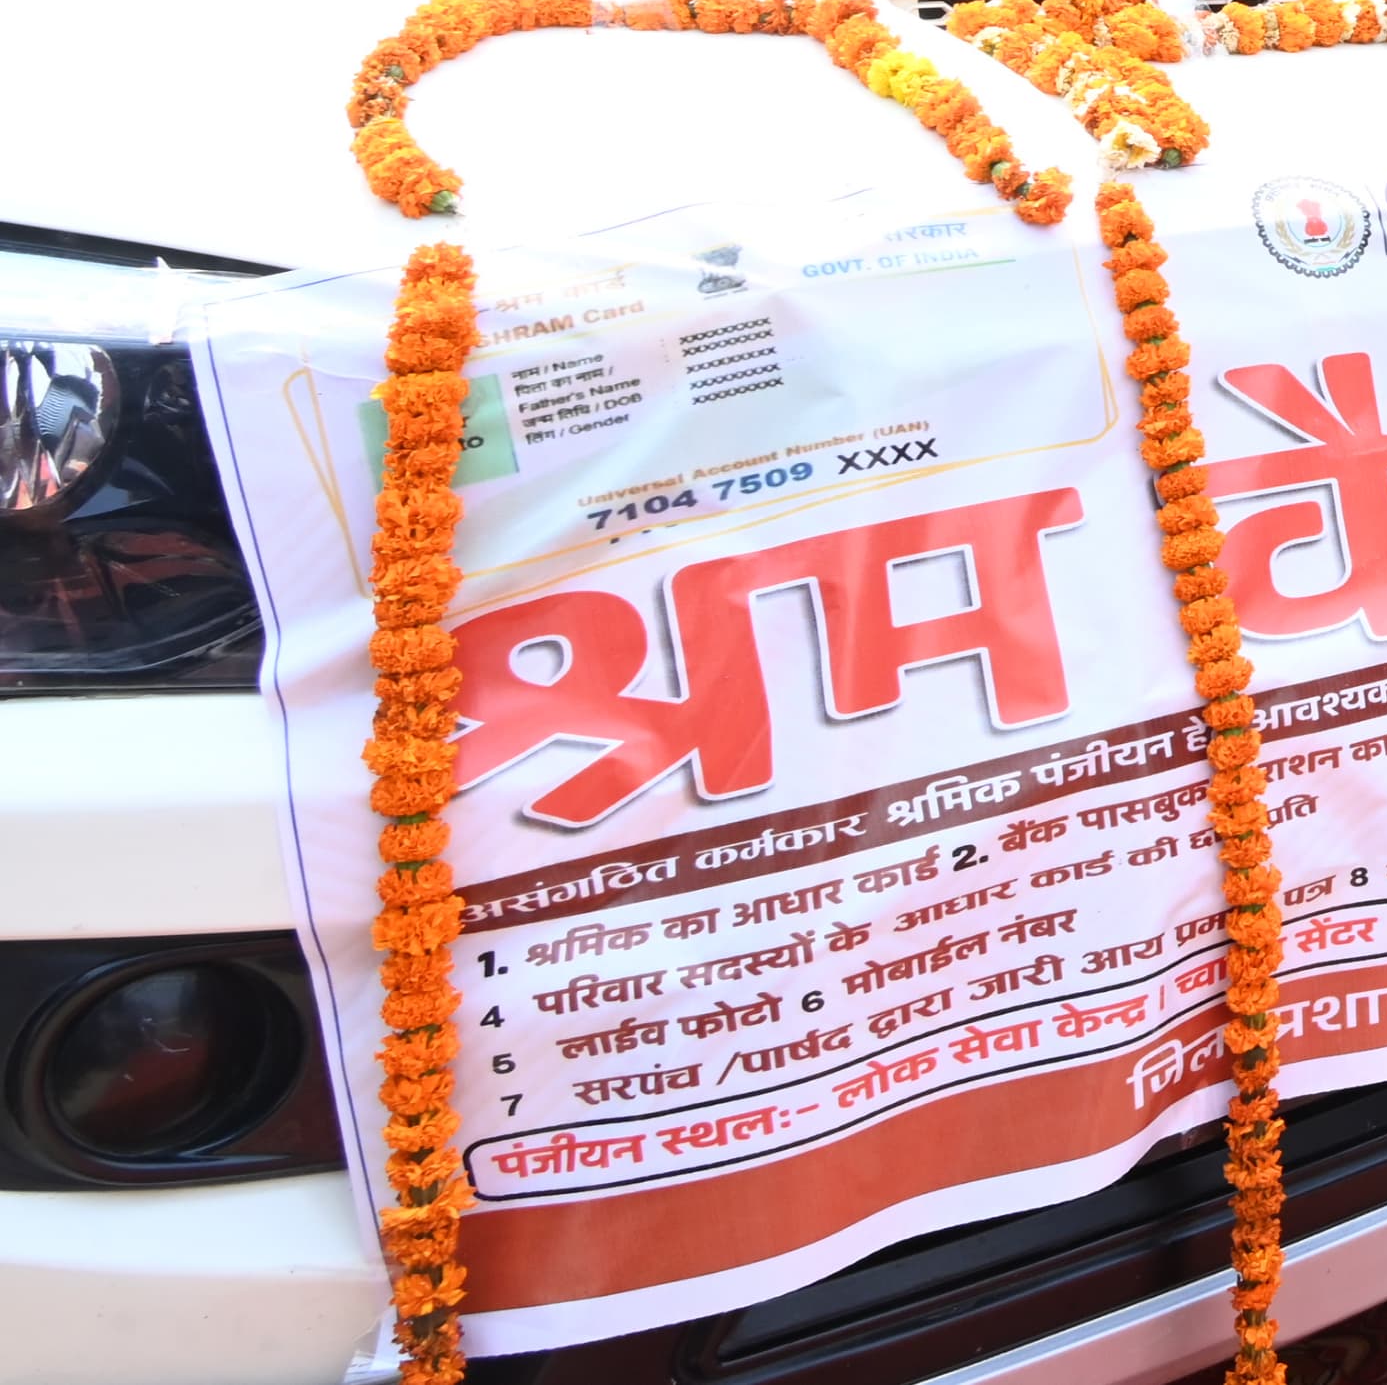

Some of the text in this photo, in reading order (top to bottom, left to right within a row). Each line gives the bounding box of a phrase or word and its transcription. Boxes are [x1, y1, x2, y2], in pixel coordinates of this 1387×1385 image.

[801, 246, 981, 278] GOVT. OF INDIA
[583, 299, 646, 325] Card
[518, 376, 642, 414] Father's Name
[552, 352, 605, 373] Name
[604, 391, 644, 411] DOB
[568, 412, 631, 437] Gender
[576, 419, 932, 508] Universal Account Number (UAN)
[586, 437, 941, 532] 7104 7509 XXXX
[448, 485, 1086, 829] श्रम
[462, 855, 680, 924] असंगठित
[695, 811, 869, 871] कर्मकार
[886, 768, 1023, 830] श्रमिक
[1029, 730, 1176, 788] पंजीयन
[477, 949, 508, 978] 1.
[525, 920, 653, 968] श्रमिक
[660, 905, 720, 942] का
[731, 878, 845, 929] आधार
[853, 844, 941, 896] कार्ड
[951, 844, 989, 873] 2.
[997, 814, 1069, 855] बैंक
[1076, 779, 1209, 831] पासबुक
[479, 1005, 506, 1030] 4
[532, 969, 669, 1017] परिवार
[676, 929, 817, 990] सदस्यों
[823, 920, 873, 956] के
[893, 877, 1021, 934] आधार
[1029, 848, 1116, 889] कार्ड
[1126, 834, 1180, 869] की
[491, 906, 1079, 1075] 5 लाईव फोटो 6 मोबाईल नंबर
[500, 1093, 525, 1117] 7
[573, 1062, 703, 1107] सरपंच
[867, 987, 956, 1040] द्वारा
[967, 955, 1066, 1002] जारी
[1079, 932, 1167, 975] आय
[1282, 872, 1337, 908] पत्र
[1349, 866, 1370, 889] 8
[491, 1130, 647, 1180] पंजीयन
[831, 1046, 939, 1111] लोक
[948, 1017, 1044, 1065] सेवा
[1051, 991, 1149, 1041] केन्द्र
[1294, 912, 1376, 956] सेंटर
[1126, 1036, 1227, 1113] जिल
